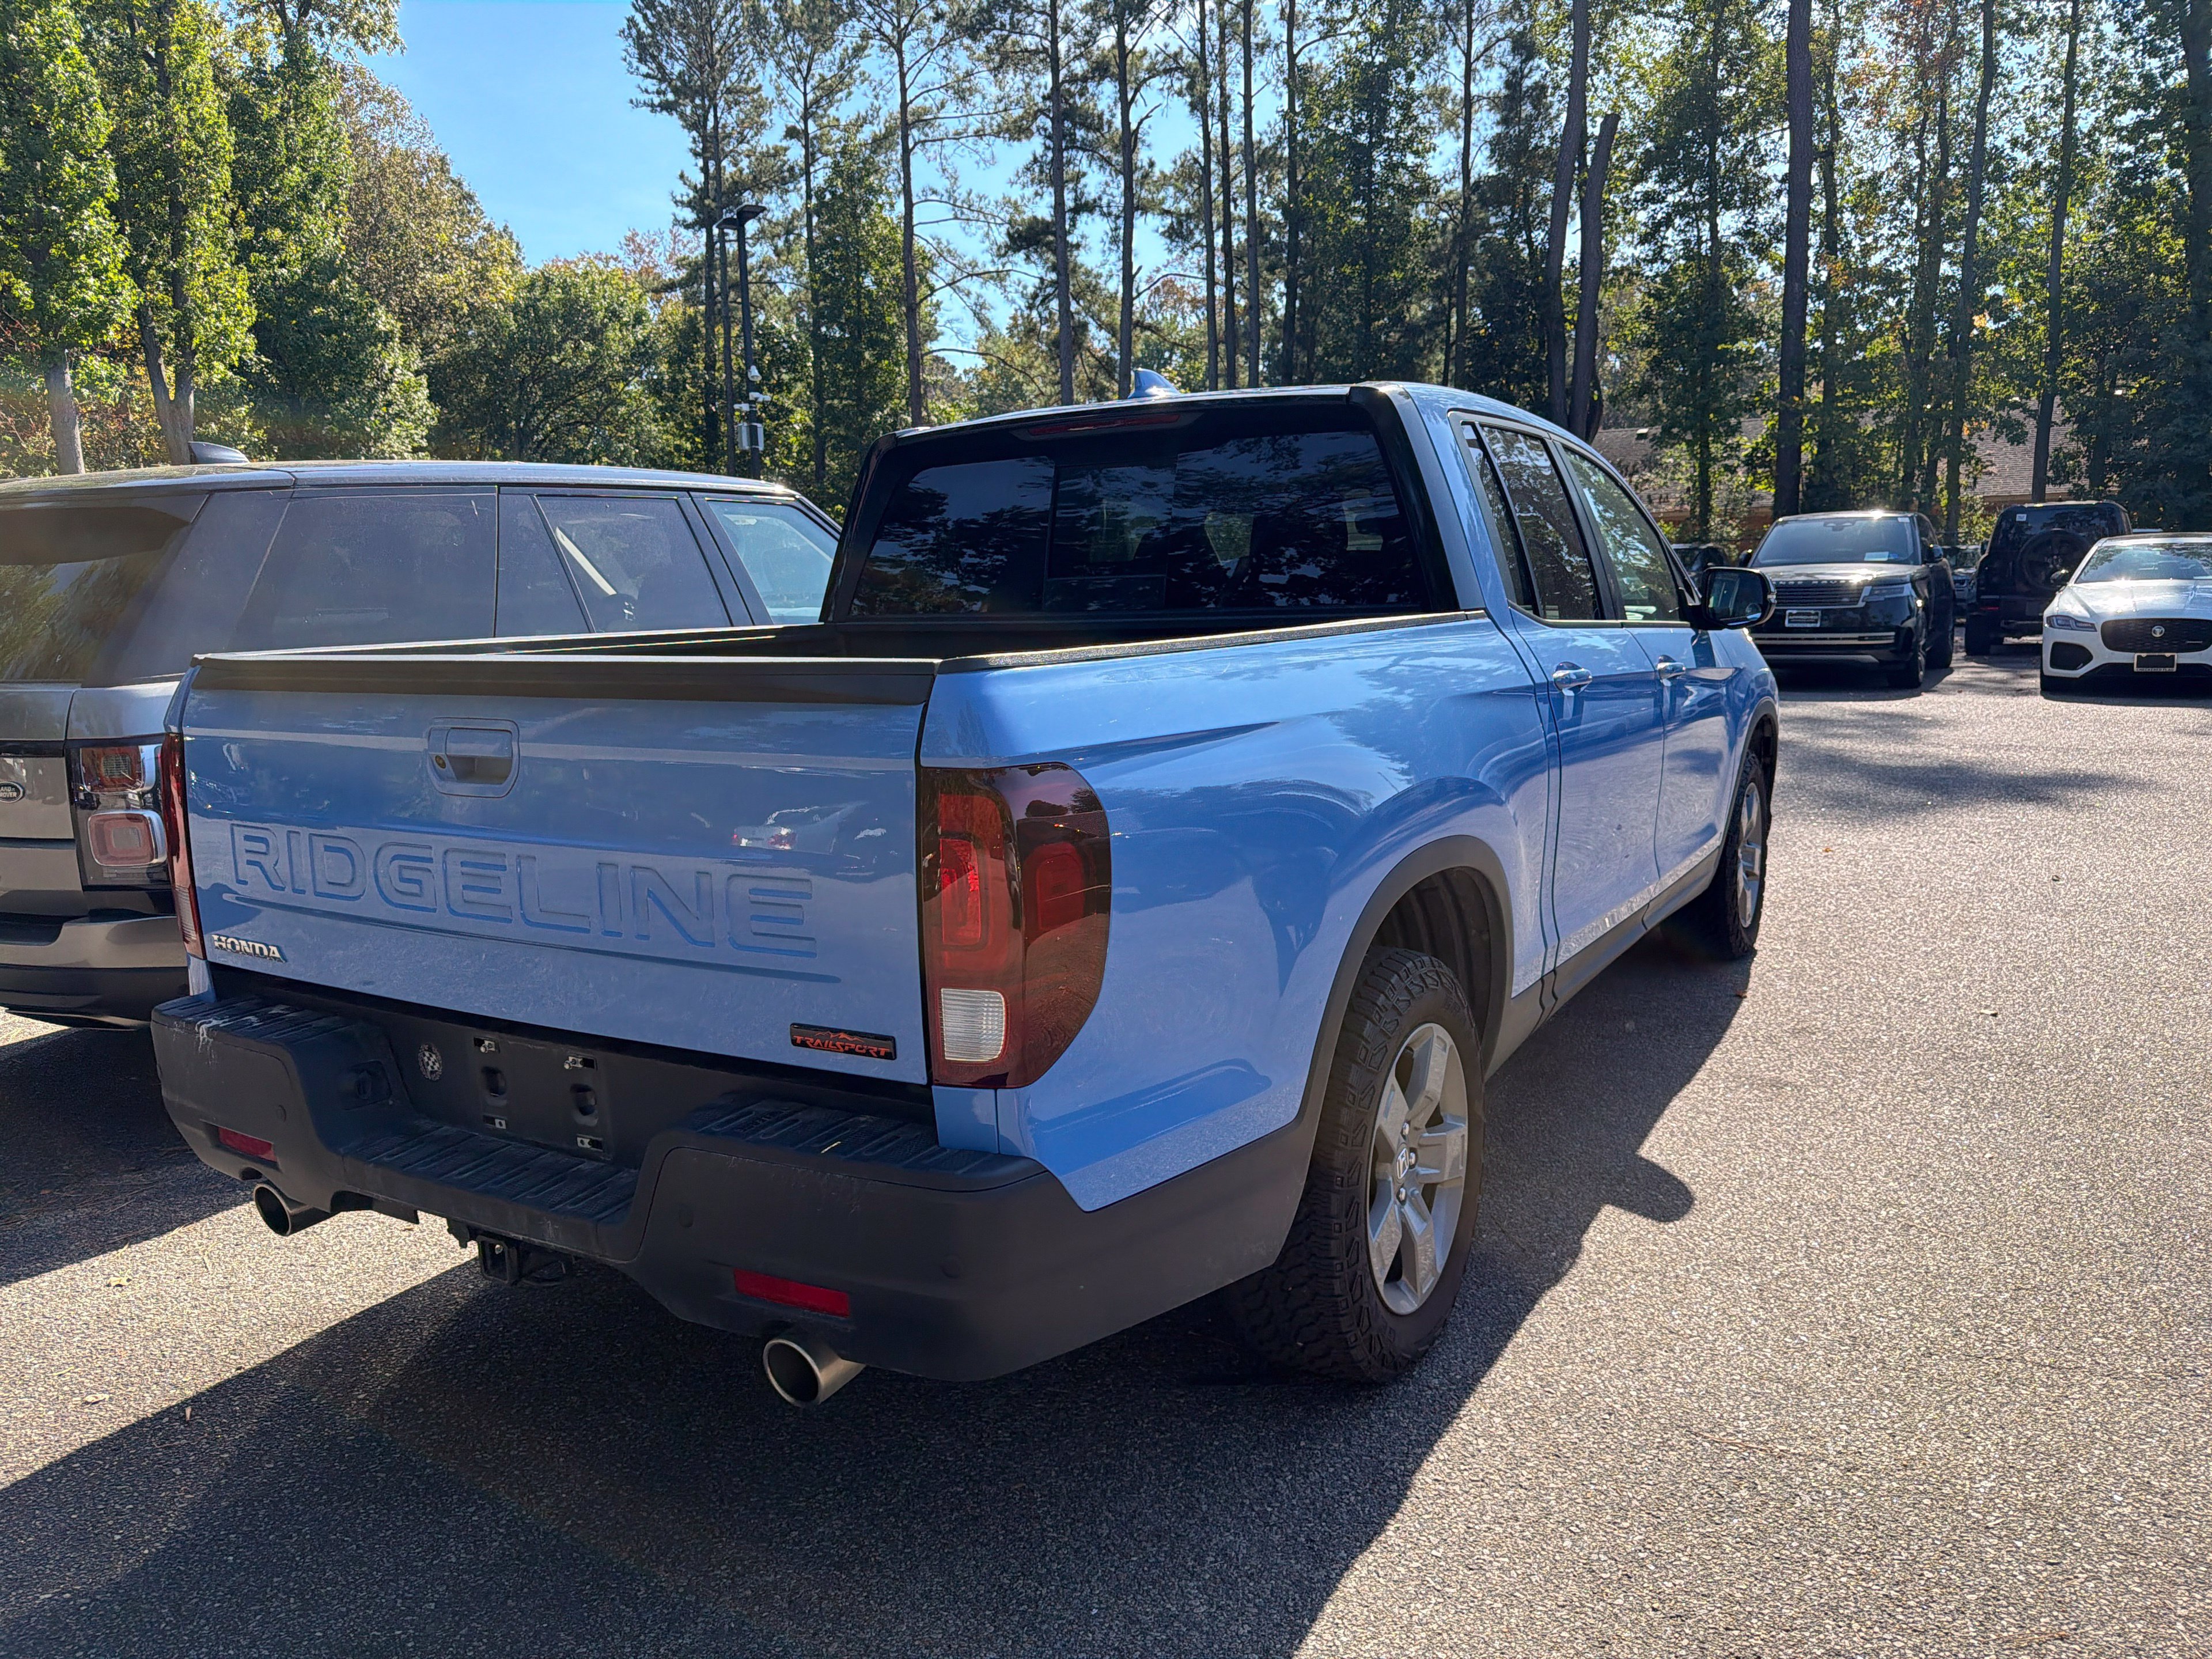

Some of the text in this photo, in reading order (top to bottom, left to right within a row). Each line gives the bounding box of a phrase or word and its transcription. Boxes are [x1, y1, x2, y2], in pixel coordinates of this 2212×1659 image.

[230, 823, 817, 959] RIDGELINE
[212, 934, 285, 963] HONDA
[793, 1035, 890, 1057] TRAILSPORT
